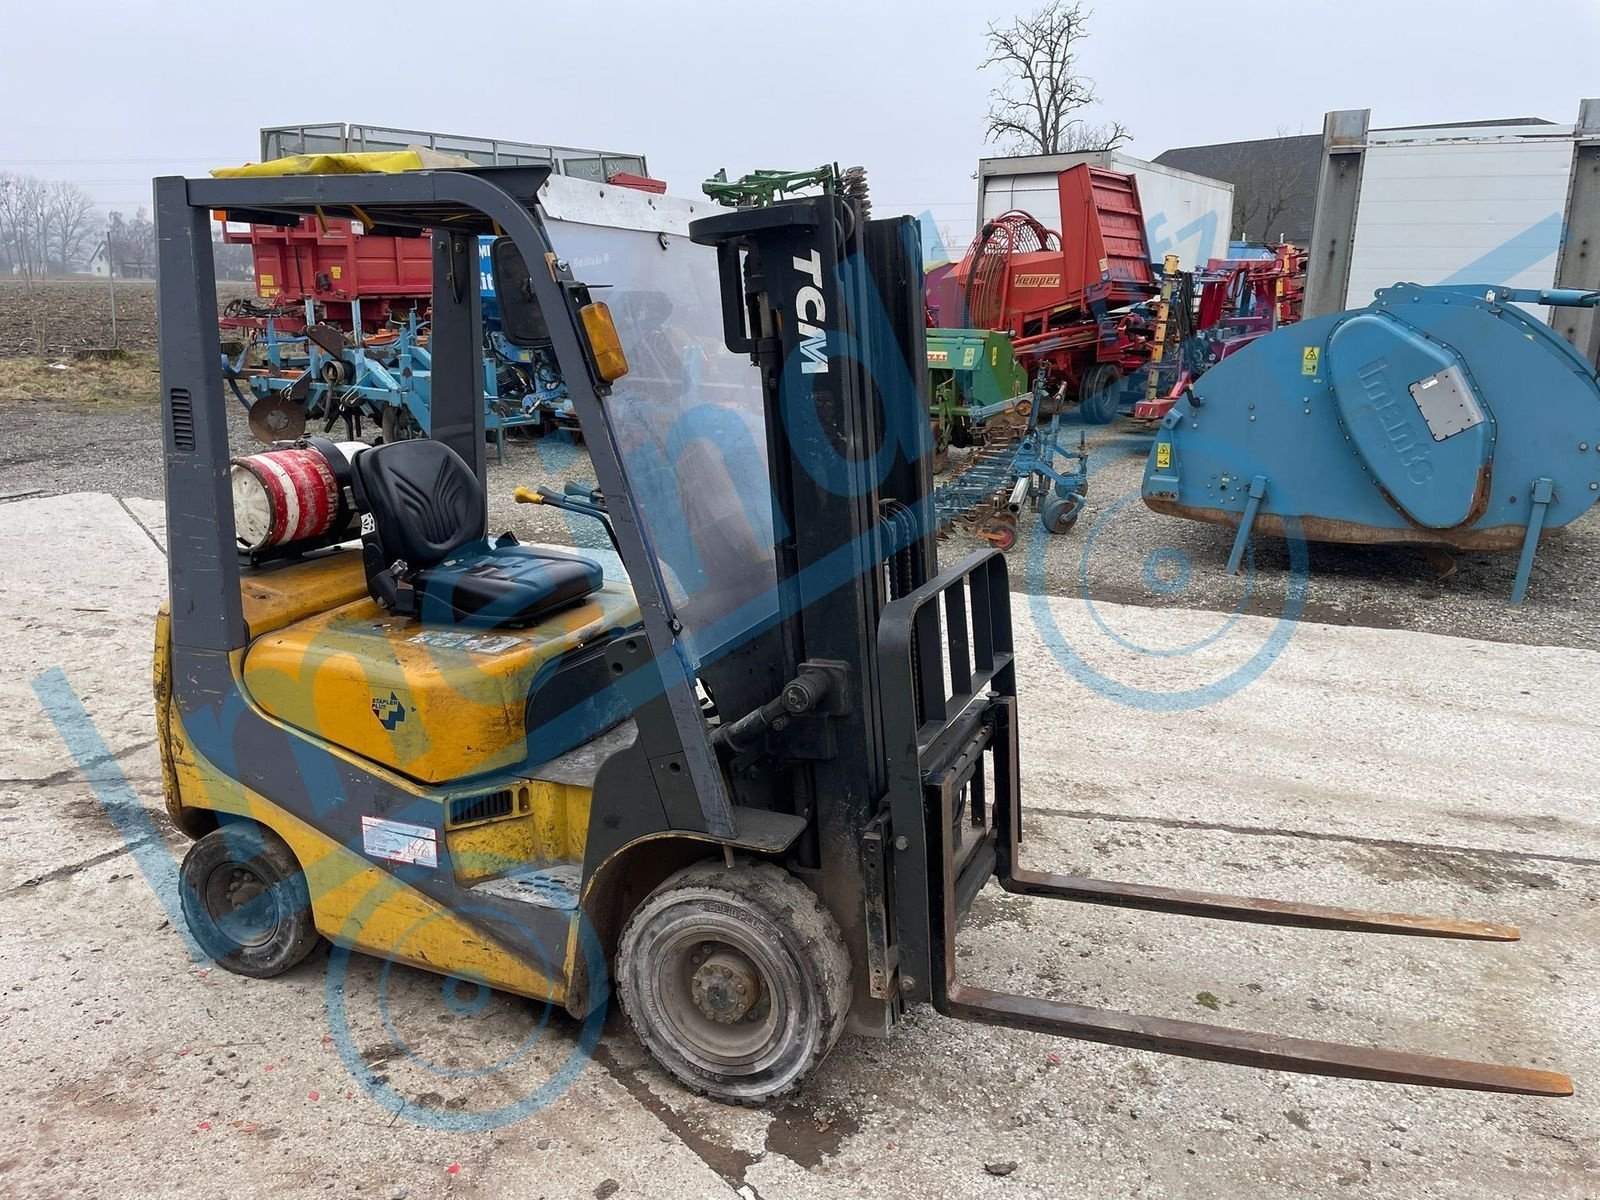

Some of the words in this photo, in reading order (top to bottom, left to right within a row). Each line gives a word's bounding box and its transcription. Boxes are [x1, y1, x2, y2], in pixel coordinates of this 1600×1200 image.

[792, 249, 829, 373] TCM
[708, 902, 737, 917] SOLID
[739, 911, 765, 934] PLUS
